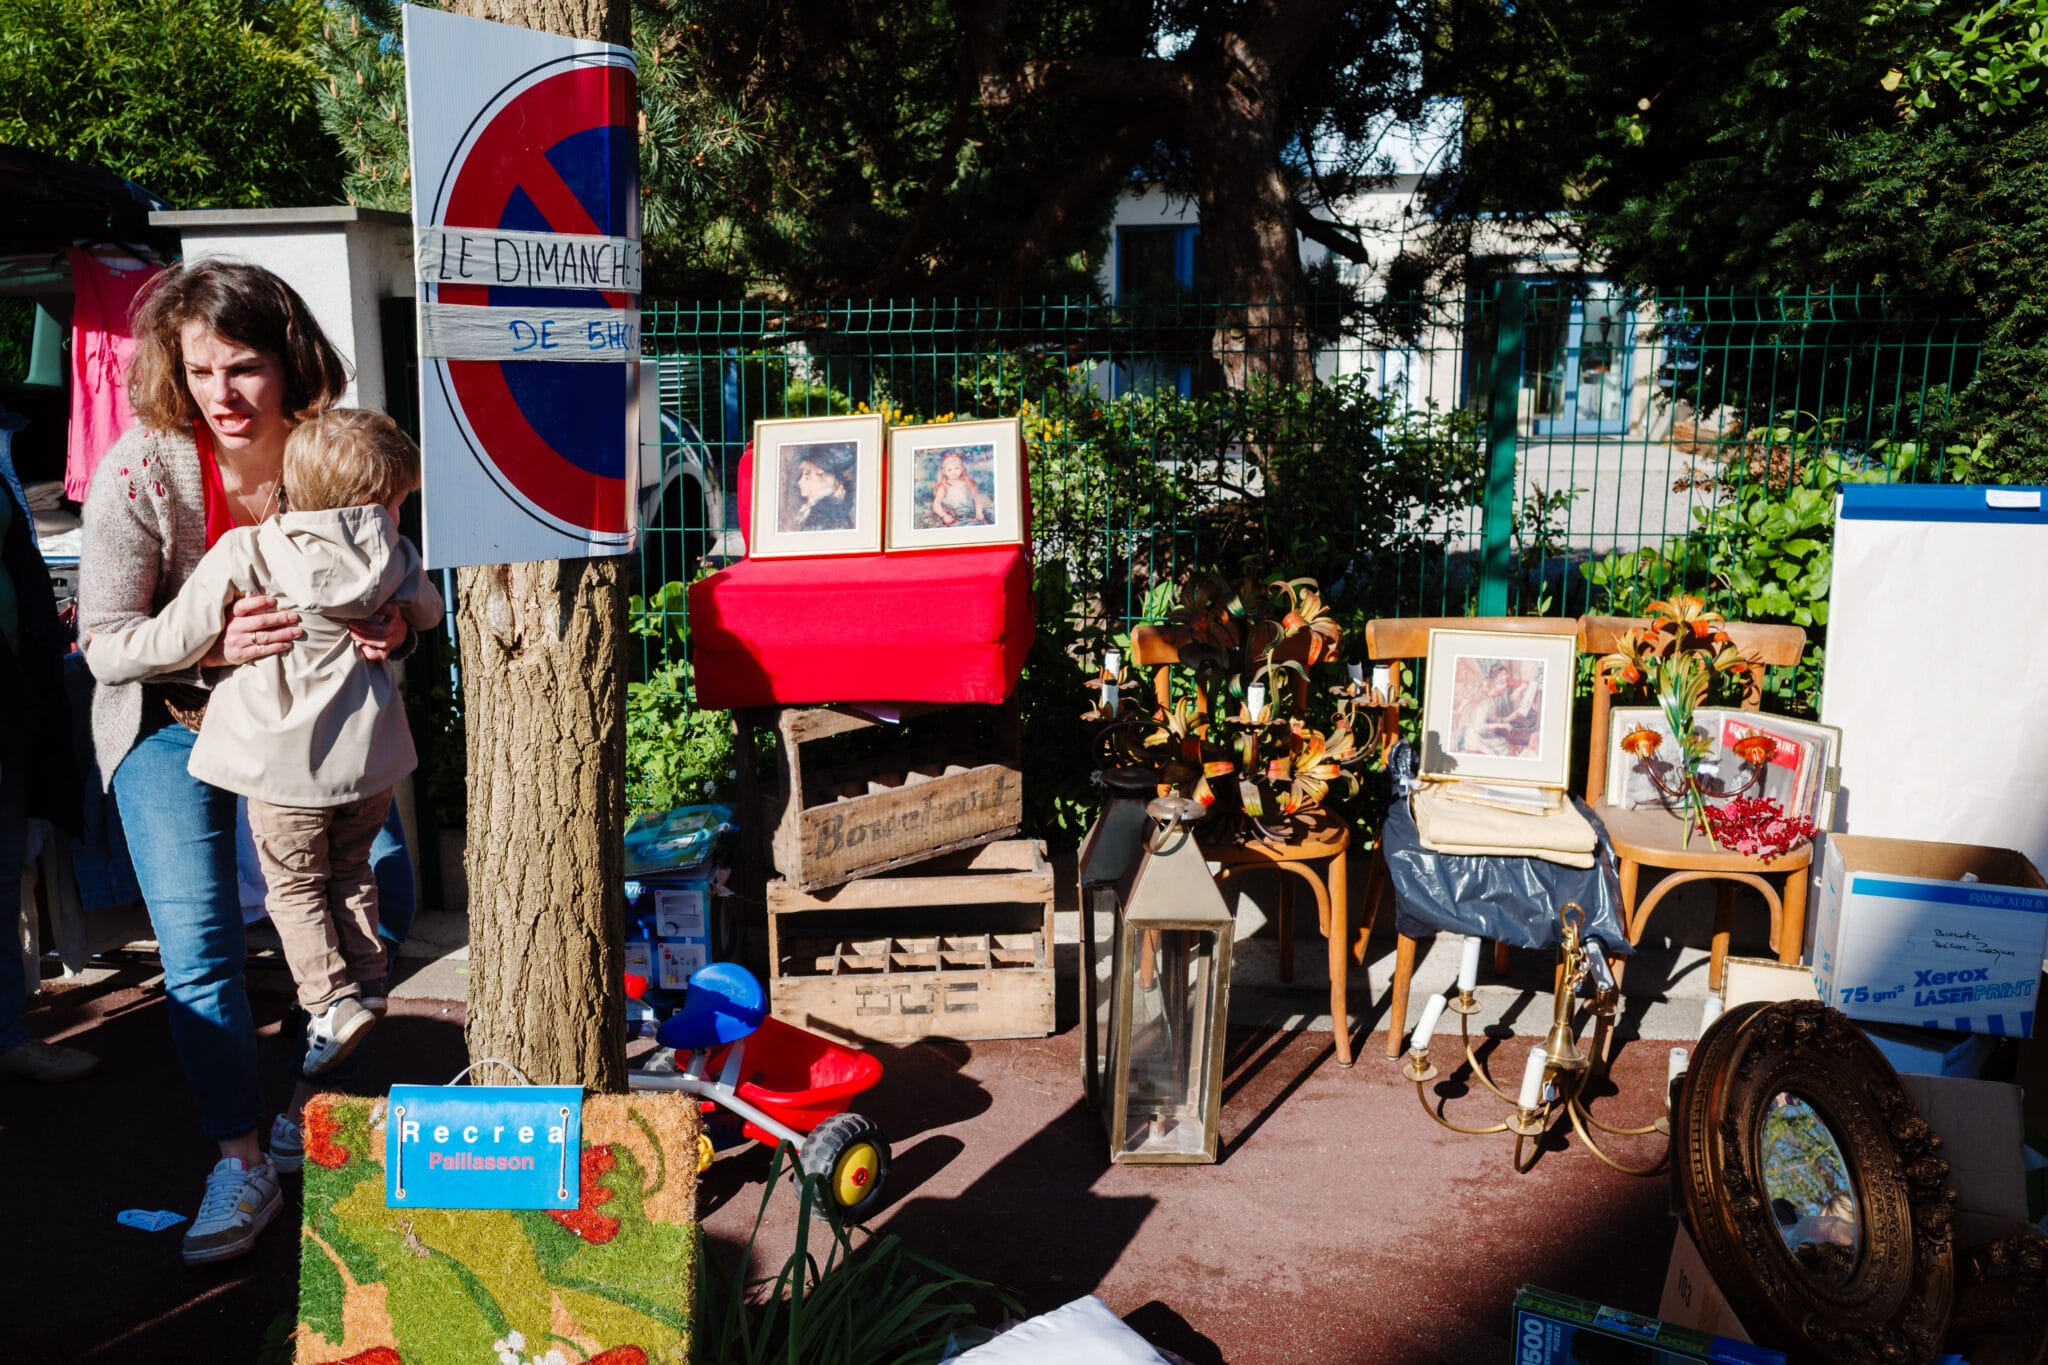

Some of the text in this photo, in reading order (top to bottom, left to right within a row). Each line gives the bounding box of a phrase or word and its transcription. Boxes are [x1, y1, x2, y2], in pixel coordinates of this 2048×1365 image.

[439, 233, 474, 280] LE
[494, 238, 631, 287] DIMANCHE
[508, 319, 559, 352] DE
[1969, 892, 2004, 905] RANK
[1914, 968, 1989, 988] Xerox
[1840, 986, 1869, 1004] 75
[402, 1121, 565, 1144] Recrea
[429, 1152, 535, 1171] Paillasson
